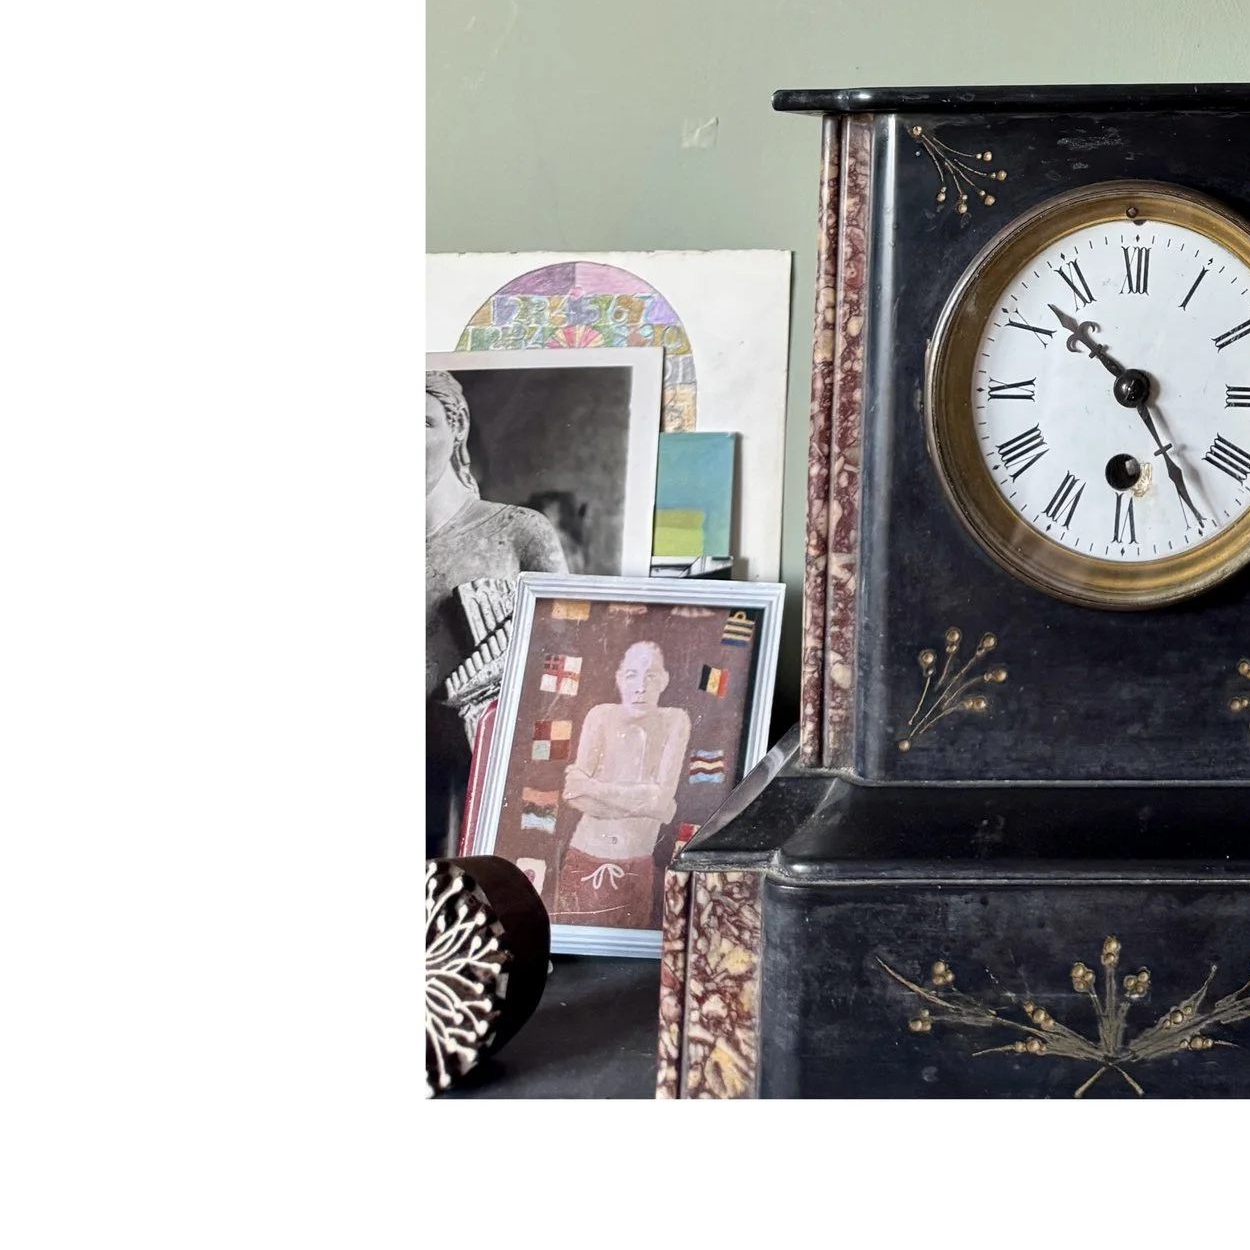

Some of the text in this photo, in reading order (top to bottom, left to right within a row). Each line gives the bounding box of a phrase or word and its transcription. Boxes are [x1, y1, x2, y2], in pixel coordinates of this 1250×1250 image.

[1054, 258, 1097, 312] XI
[1120, 246, 1151, 295] XII
[1179, 266, 1209, 311] I
[1005, 308, 1057, 348] X
[988, 377, 1037, 402] IX
[997, 423, 1050, 483] VIII
[1042, 470, 1086, 530] VII
[1112, 492, 1138, 544] VI
